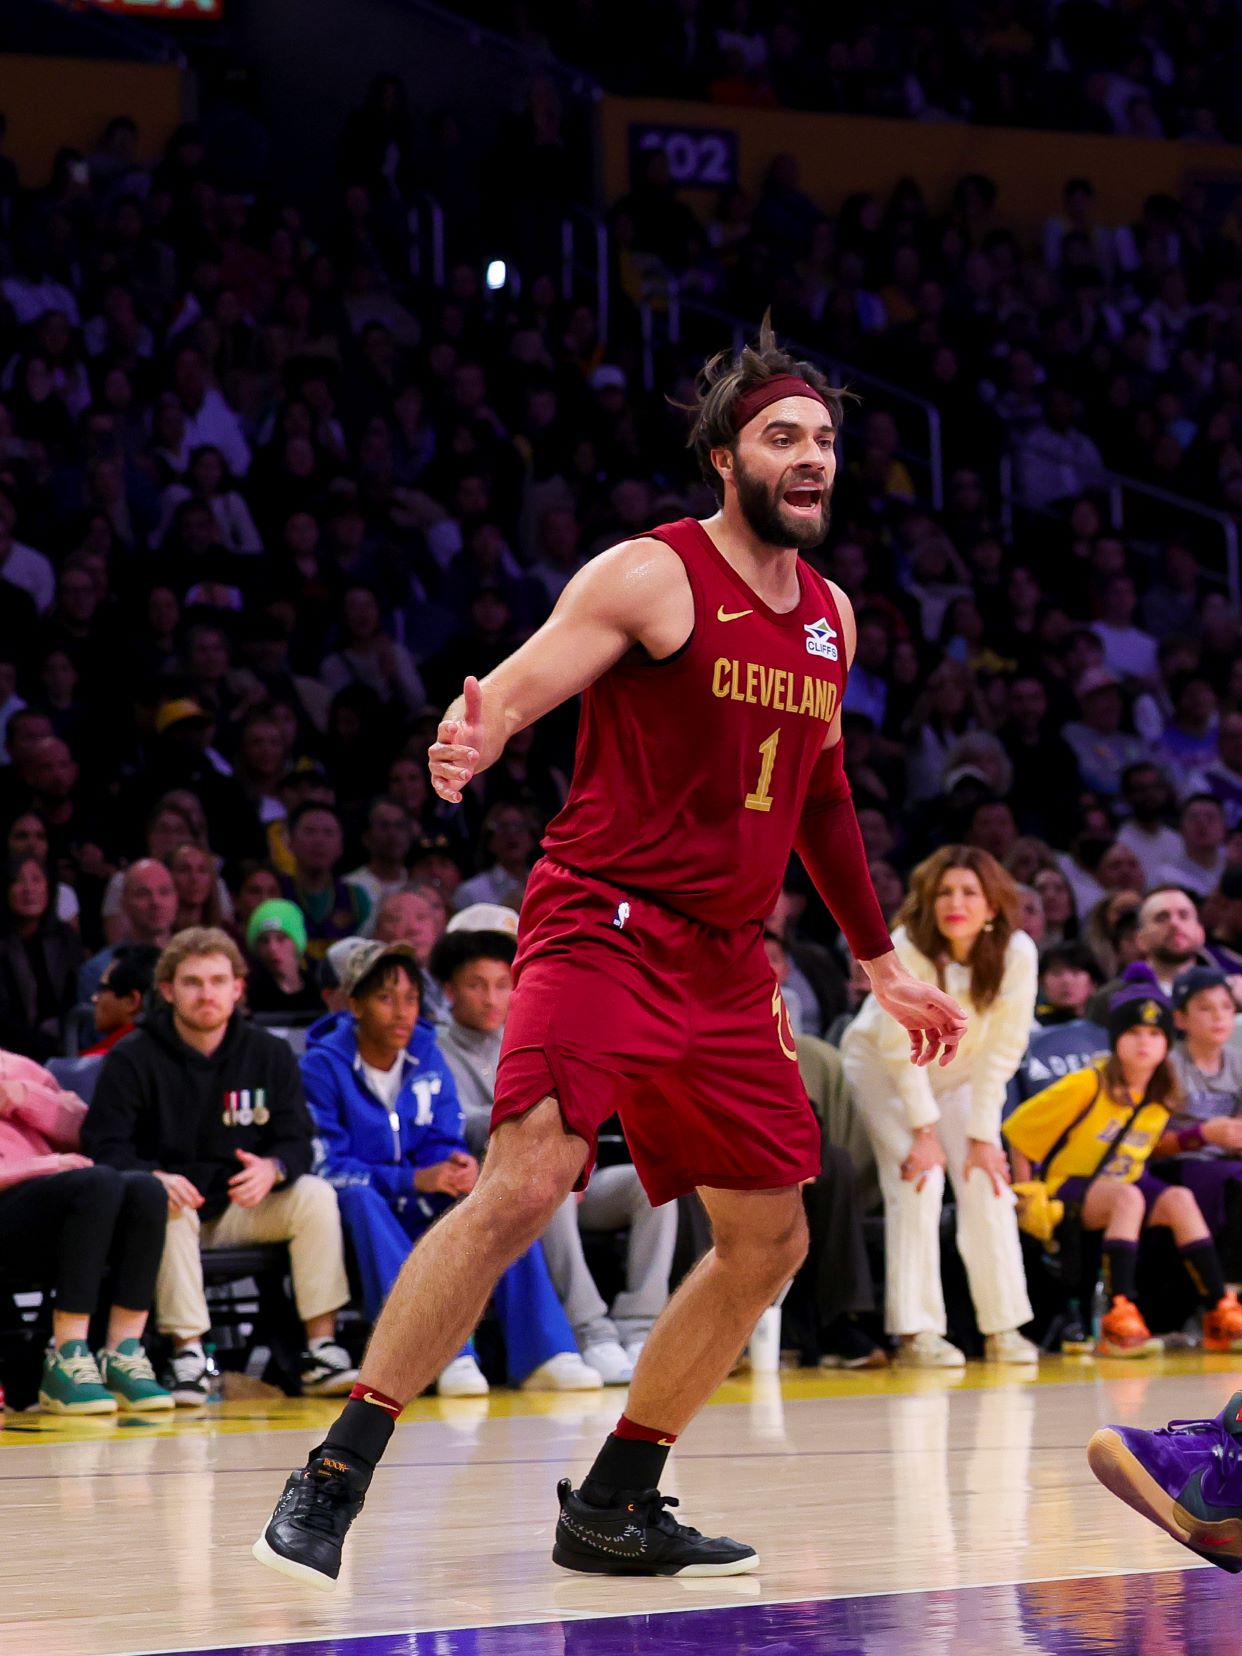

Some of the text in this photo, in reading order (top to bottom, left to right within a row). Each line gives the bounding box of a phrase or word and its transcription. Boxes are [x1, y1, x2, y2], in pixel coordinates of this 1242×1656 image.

[807, 641, 838, 659] CLIFFS
[711, 656, 838, 724] CLEVELAND
[743, 727, 782, 813] 1
